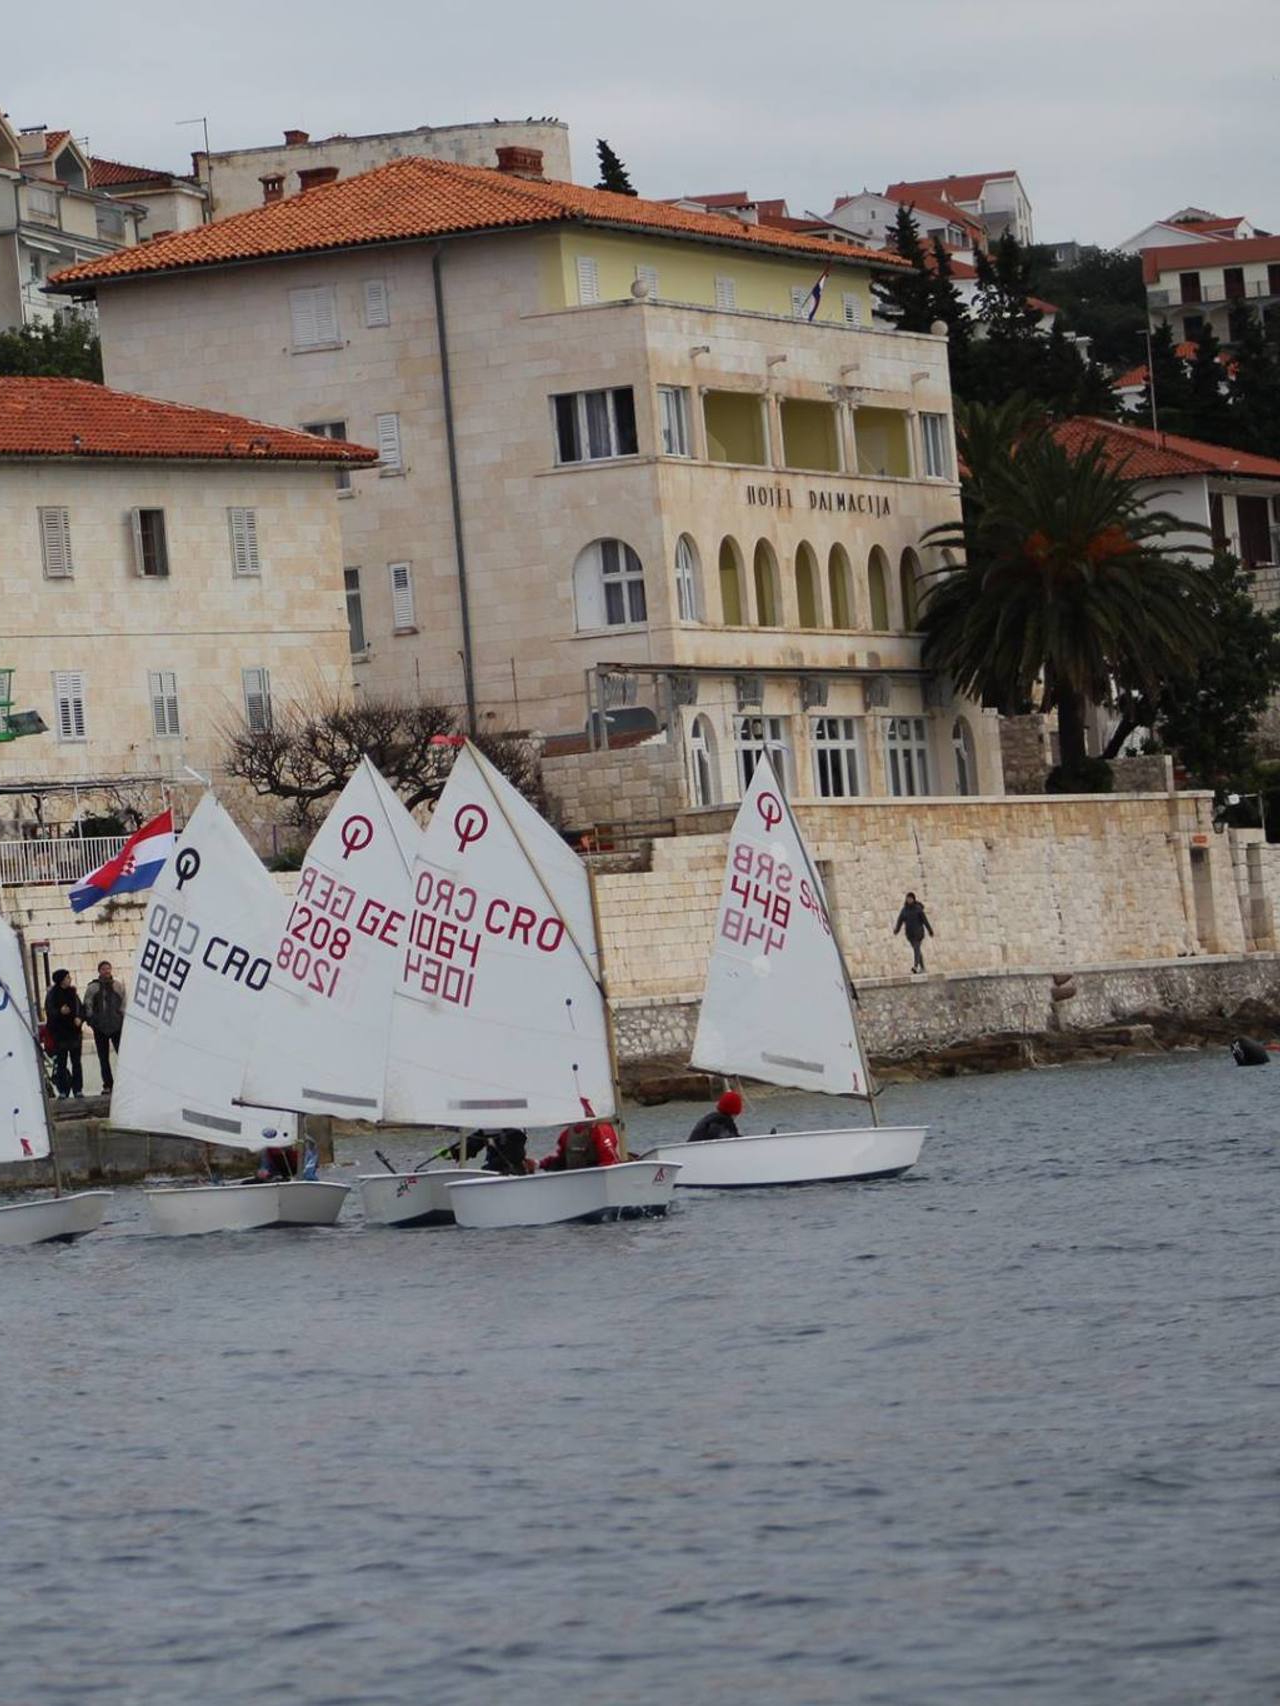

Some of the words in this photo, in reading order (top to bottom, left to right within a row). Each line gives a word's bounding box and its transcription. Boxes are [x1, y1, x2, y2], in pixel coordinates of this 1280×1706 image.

[356, 898, 407, 948] GE
[484, 898, 566, 953] CRO
[731, 874, 791, 930] 448
[286, 900, 352, 960] 1208
[408, 909, 482, 968] 1064
[140, 938, 192, 992] 889
[203, 936, 272, 991] CRO
